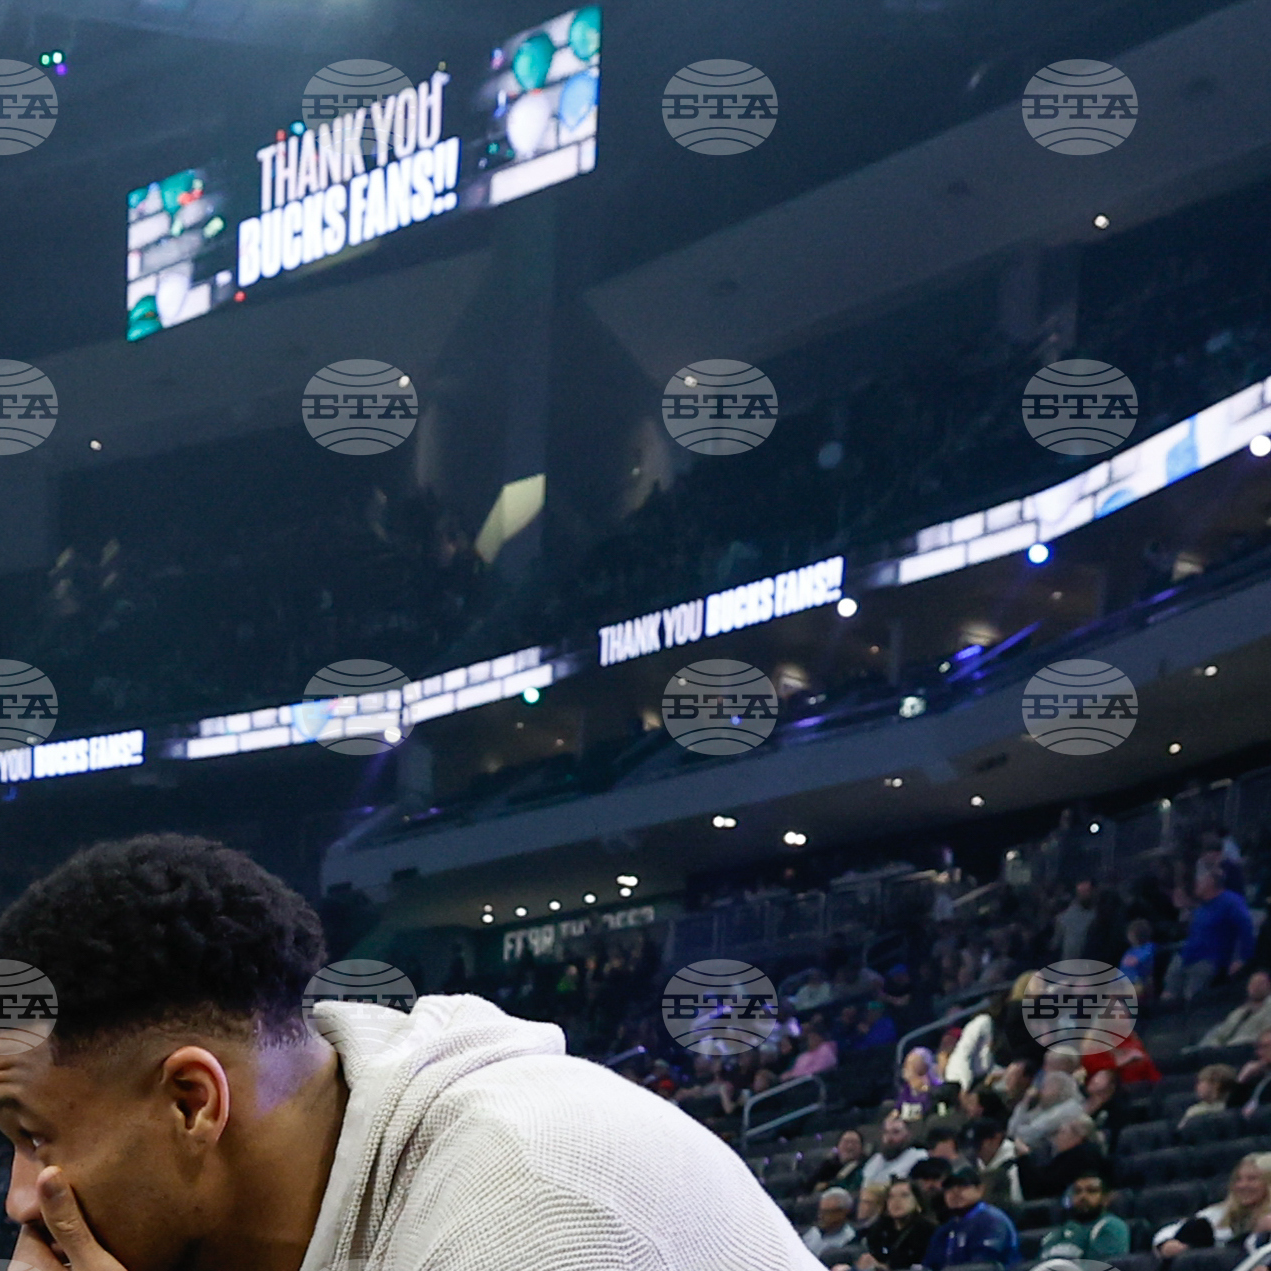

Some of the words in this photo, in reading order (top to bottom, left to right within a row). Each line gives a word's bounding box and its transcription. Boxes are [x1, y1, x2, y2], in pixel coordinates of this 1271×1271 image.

[237, 184, 347, 287] BUCKS
[348, 137, 460, 247] FANS!!
[257, 108, 367, 212] THANK
[371, 71, 445, 167] YOU
[598, 611, 662, 667] THANK
[663, 598, 704, 648] YOU
[705, 577, 774, 637] BUCKS
